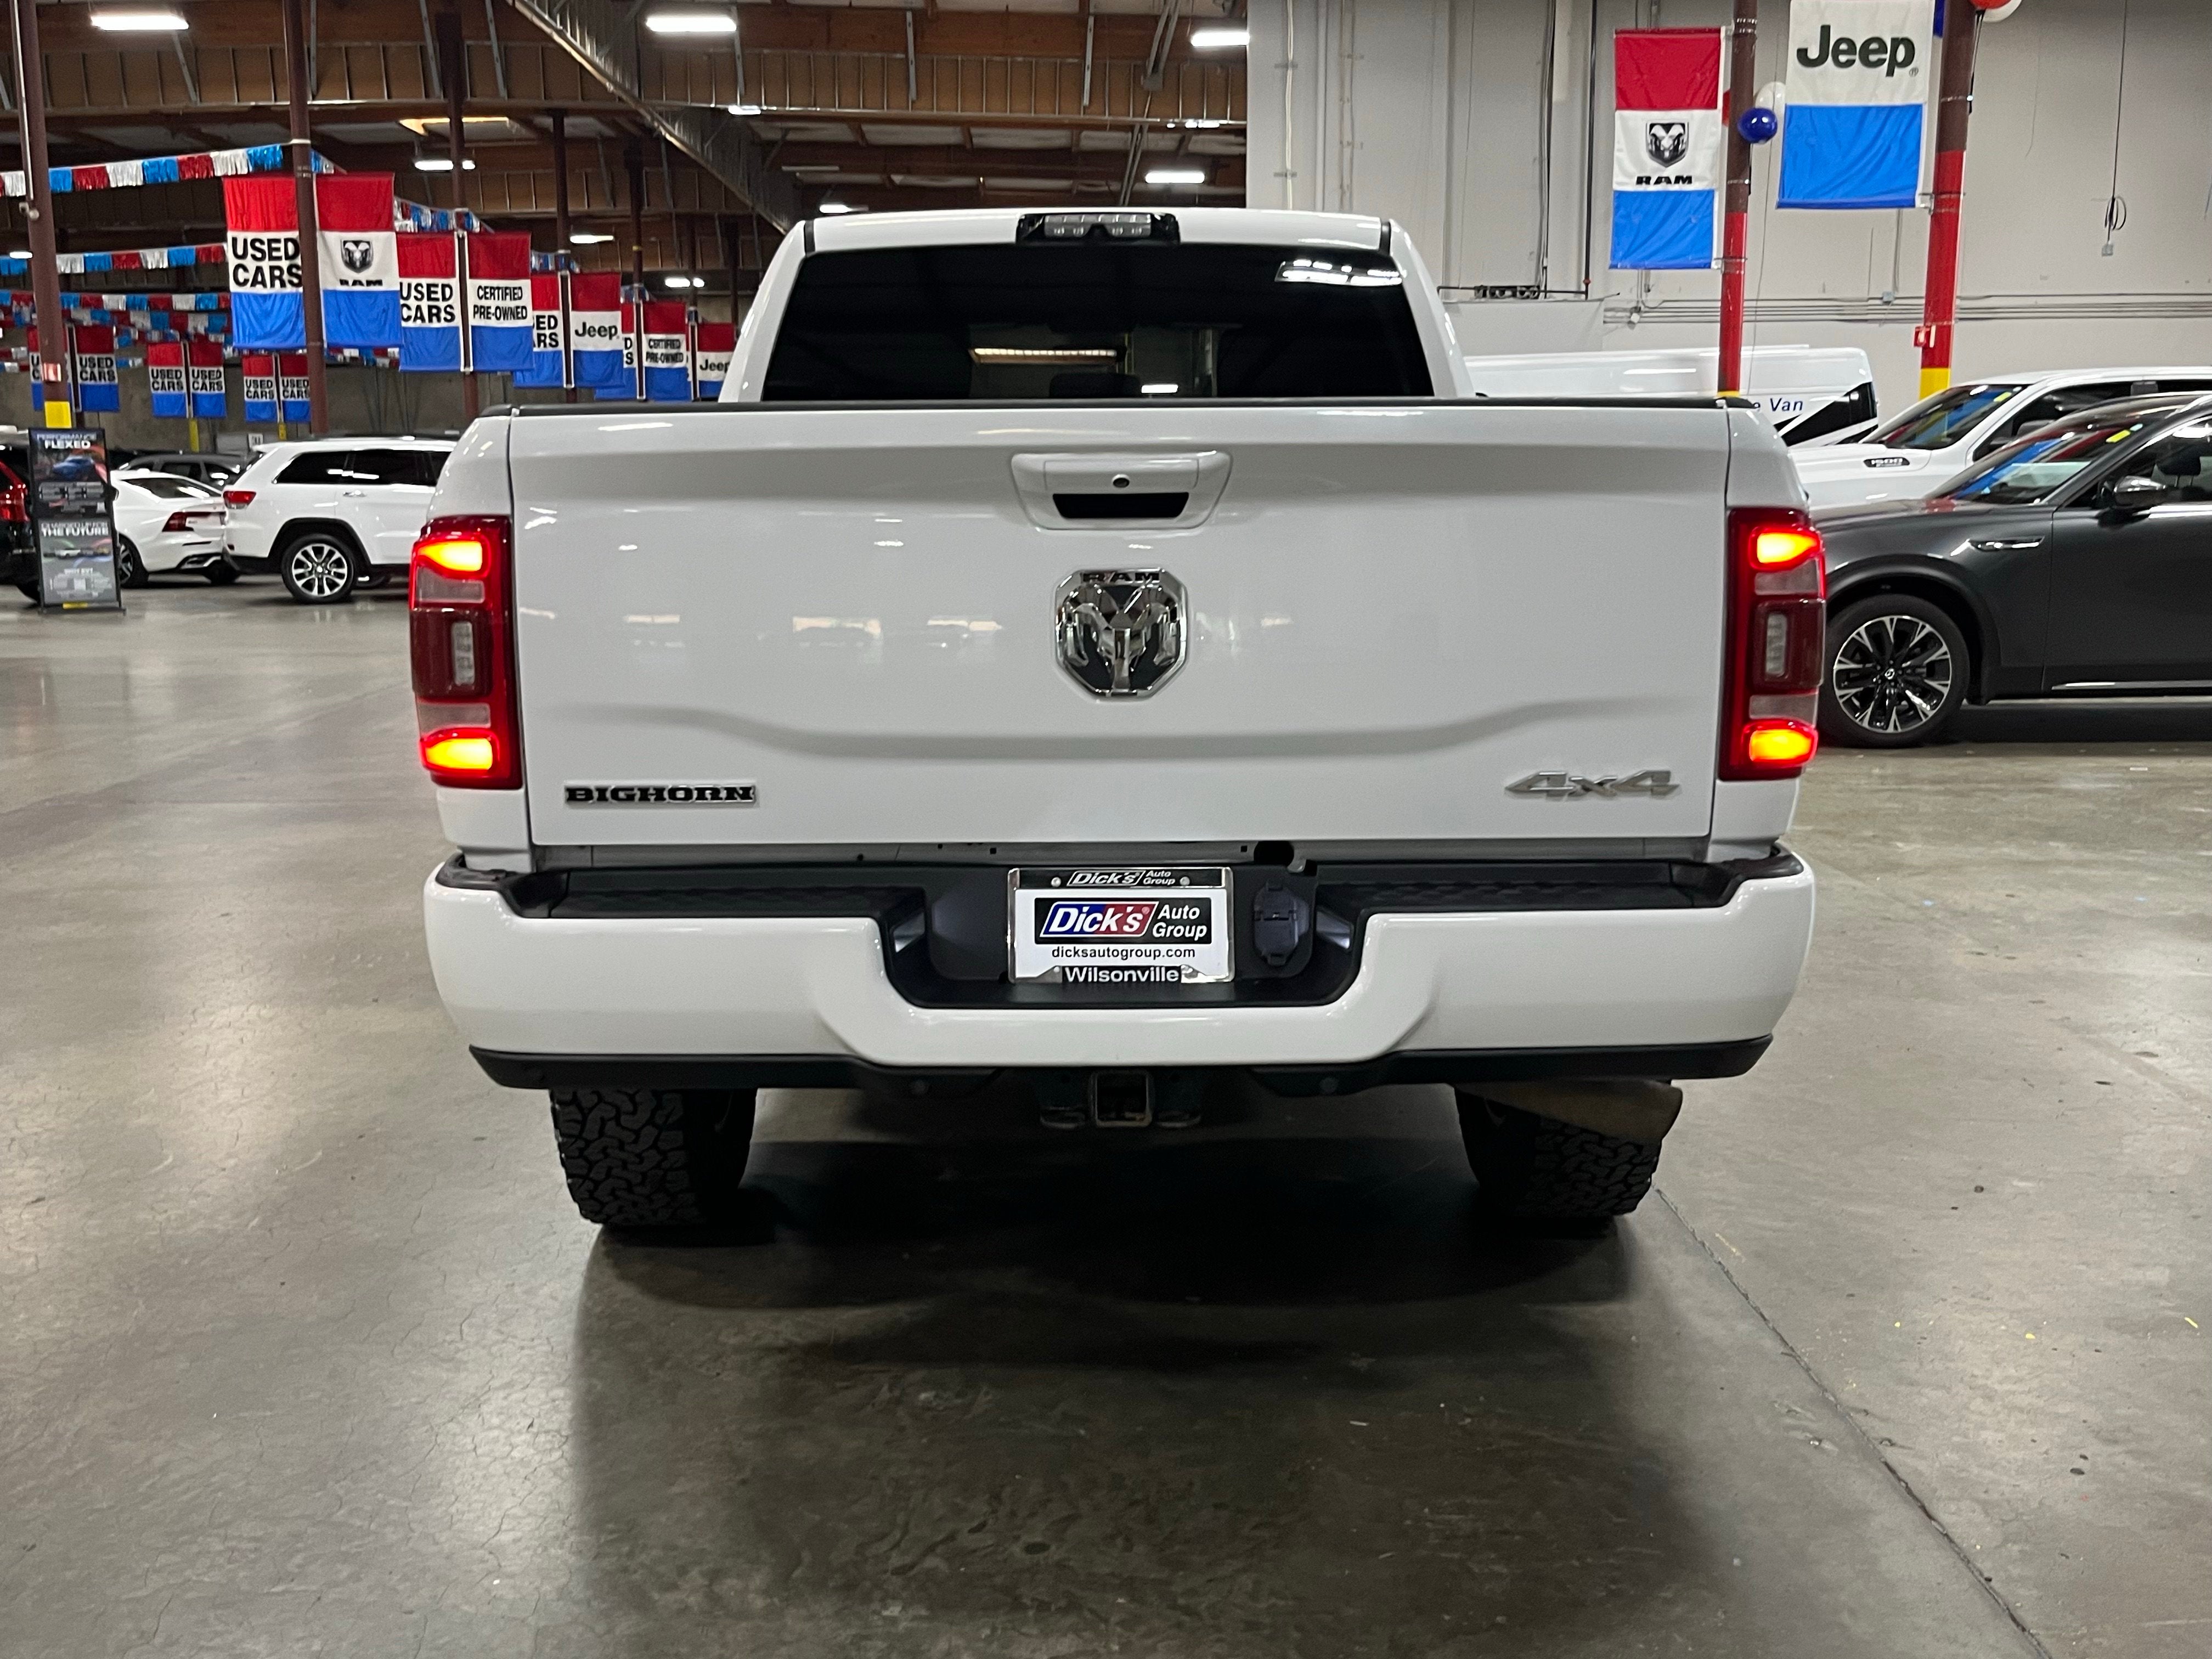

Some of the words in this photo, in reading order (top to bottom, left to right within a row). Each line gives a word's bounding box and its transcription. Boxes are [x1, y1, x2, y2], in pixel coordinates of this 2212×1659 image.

[1797, 25, 1916, 76] Jeep
[1635, 175, 1692, 185] RAM
[232, 237, 300, 262] USED
[233, 263, 302, 289] CARS
[400, 282, 453, 302] USED
[477, 285, 523, 301] CERTIFIED
[401, 303, 456, 323] CARS
[473, 304, 528, 320] PRE-OWNED
[533, 315, 558, 330] ED
[574, 321, 618, 340] Jeep
[533, 332, 559, 348] RS
[80, 357, 114, 368] USED
[80, 369, 116, 381] CARS
[151, 369, 182, 379] USED
[192, 369, 222, 380] USED
[151, 381, 184, 391] CARS
[192, 381, 223, 391] CARS
[245, 379, 273, 388] USED
[282, 379, 309, 388] USED
[246, 390, 274, 399] CARS
[1770, 398, 1803, 411] Van
[44, 440, 91, 449] FLEXED
[1082, 573, 1160, 582] RAM
[1505, 770, 1680, 797] 4x4
[565, 785, 755, 803] BIGHORN
[1072, 872, 1137, 884] Dick's
[1143, 877, 1175, 885] Group
[1048, 906, 1143, 933] Dick's
[1158, 905, 1200, 919] Auto
[1153, 923, 1207, 940] Group
[1052, 946, 1195, 960] dicksautogroup.com
[1064, 967, 1179, 982] Wilsonville
